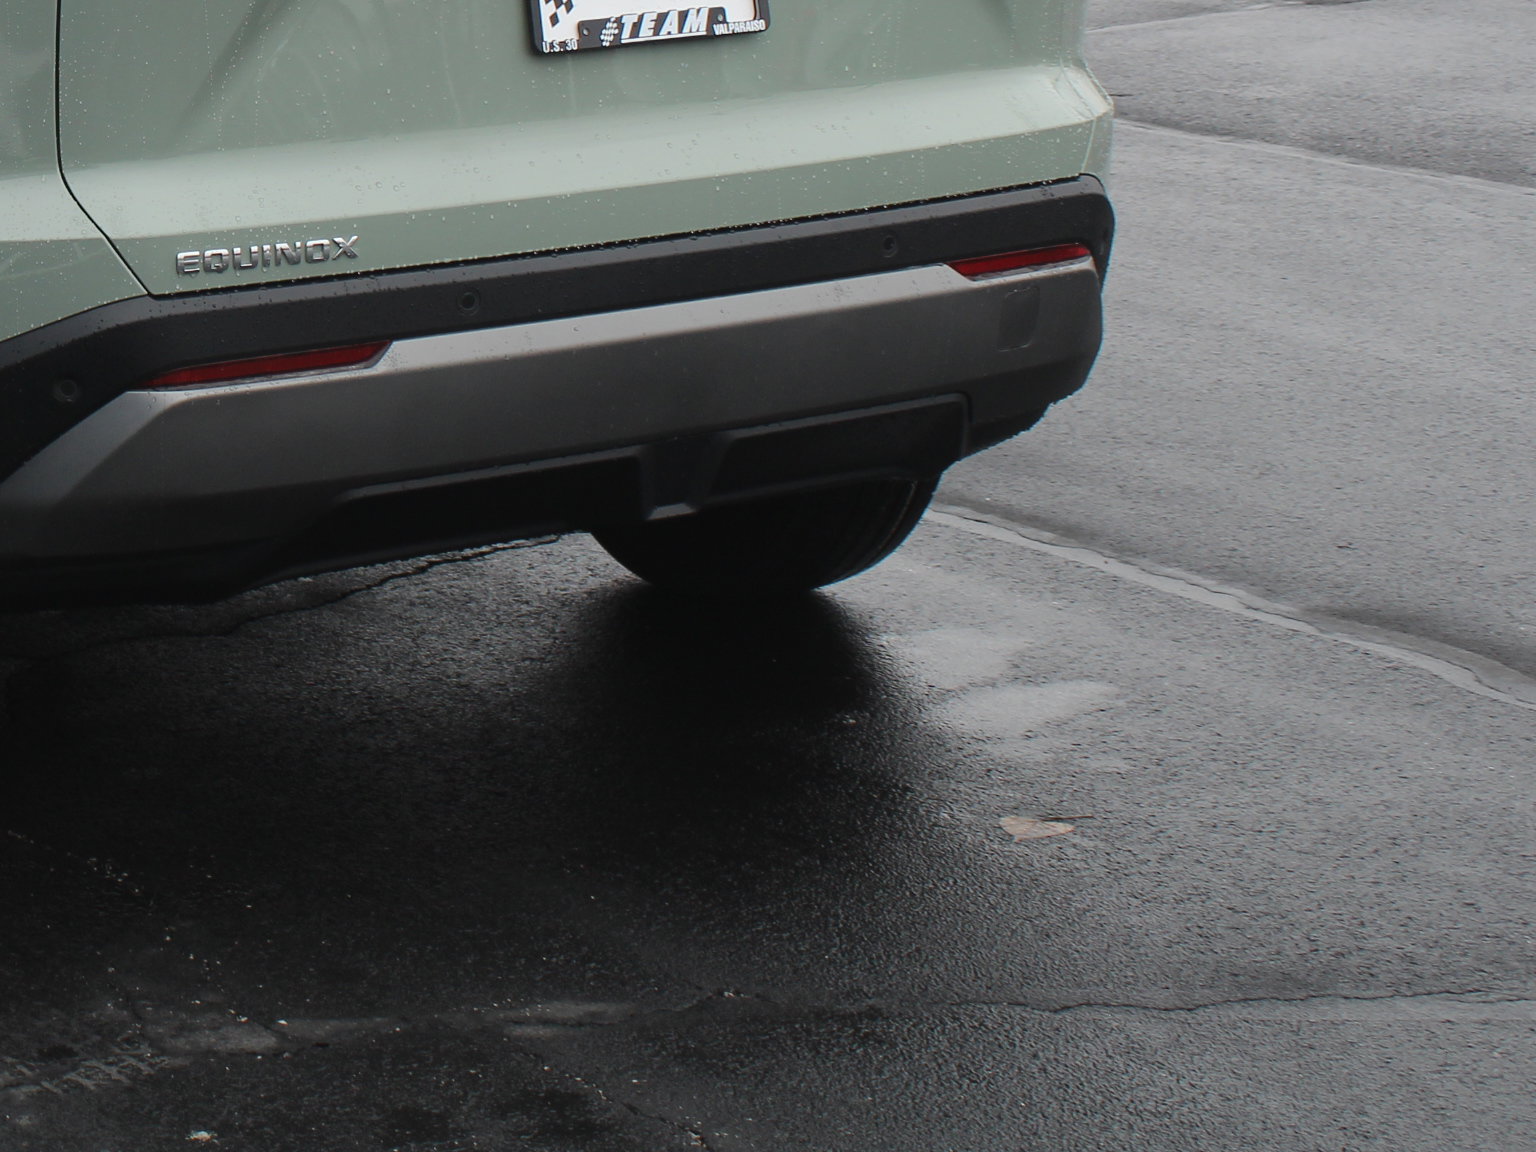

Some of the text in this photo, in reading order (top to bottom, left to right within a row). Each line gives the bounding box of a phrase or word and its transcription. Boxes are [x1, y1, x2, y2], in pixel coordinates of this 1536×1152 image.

[620, 7, 710, 40] TEAM
[713, 19, 766, 36] VALPARAISO
[566, 39, 579, 52] 30
[175, 235, 360, 275] EQUINOX
